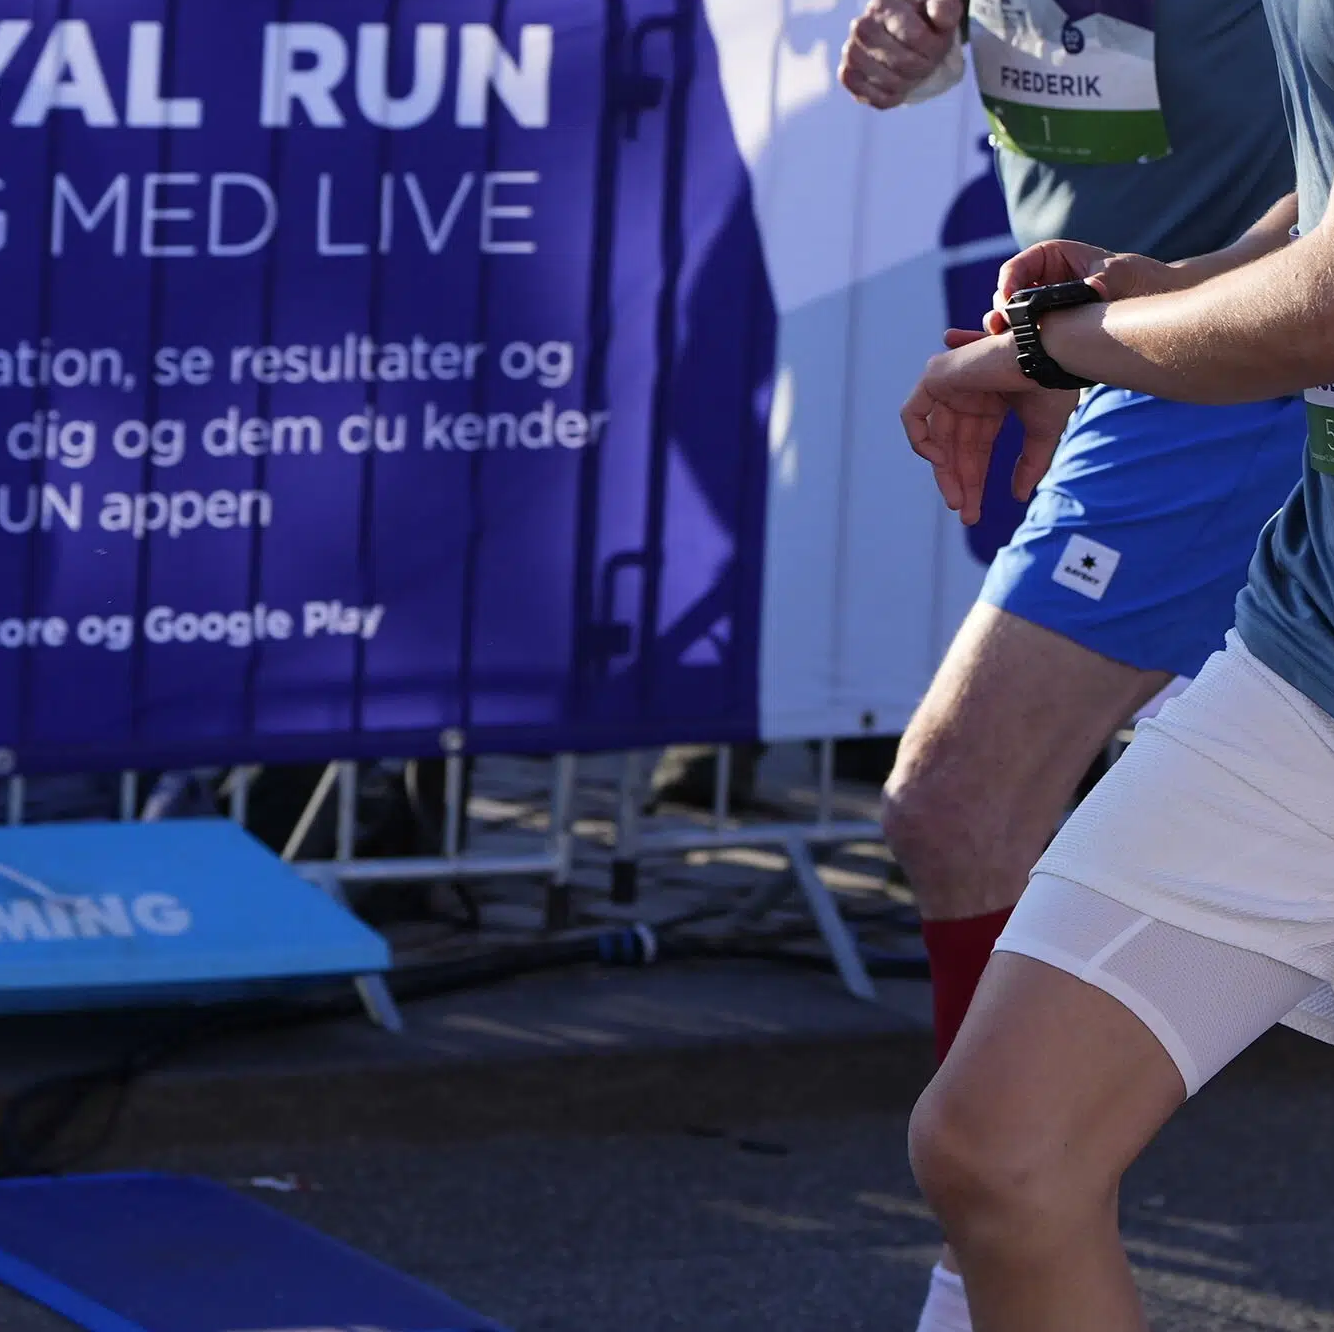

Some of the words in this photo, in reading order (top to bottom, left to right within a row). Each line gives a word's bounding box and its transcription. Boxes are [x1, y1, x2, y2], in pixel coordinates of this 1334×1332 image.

[260, 21, 555, 130] RUN
[1000, 66, 1102, 97] FREDERIK
[50, 170, 278, 258] MED
[316, 169, 542, 257] LIVE
[153, 345, 215, 386] se
[229, 332, 485, 384] resultater
[499, 339, 575, 389] og
[6, 409, 98, 469] dig
[111, 418, 186, 468] og
[201, 406, 324, 457] dem
[336, 406, 407, 455] du
[422, 399, 611, 451] kender
[97, 488, 273, 539] appen
[76, 614, 135, 651] og
[143, 603, 294, 648] Google
[302, 600, 385, 640] Play
